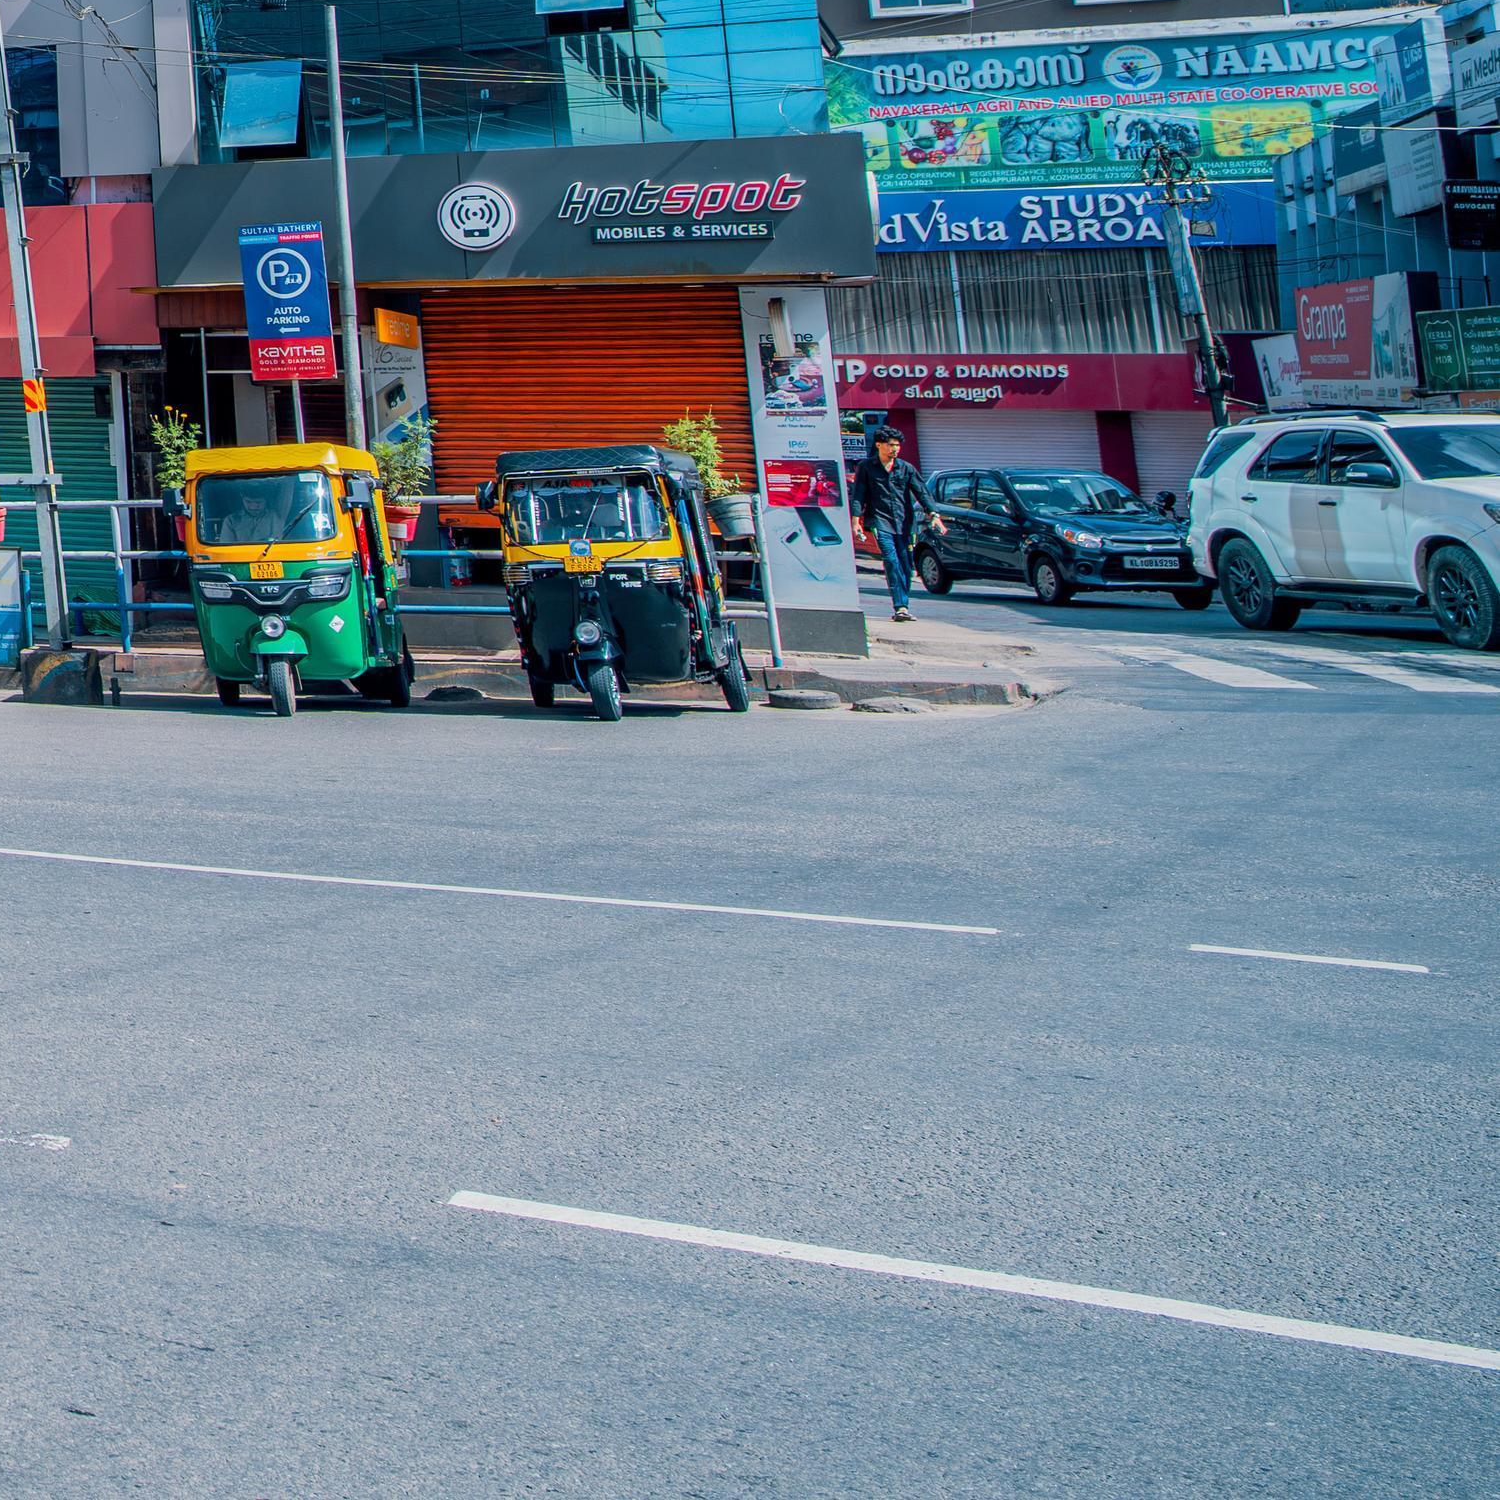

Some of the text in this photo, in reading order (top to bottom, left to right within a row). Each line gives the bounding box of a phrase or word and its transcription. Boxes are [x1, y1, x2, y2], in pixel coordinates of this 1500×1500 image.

[869, 83, 1344, 119] NAVAKERALA AGRI AND ALLIED MULTI STATE CO-OPERATIVE
[908, 170, 956, 179] OPERATION
[970, 169, 1020, 178] REGISTERED
[1019, 193, 1148, 219] STUDY
[241, 224, 318, 236] SULTAN BATHERY
[597, 223, 768, 240] MOBILES & SERVICES
[1020, 217, 1190, 245] ABROA
[268, 260, 290, 286] P
[274, 306, 301, 315] AUTO
[266, 315, 310, 325] PARKING
[1300, 294, 1347, 349] Granpa
[873, 365, 928, 379] GOLD
[935, 365, 950, 378] &
[956, 364, 1069, 379] DIAMONDS
[259, 585, 280, 594] TVS
